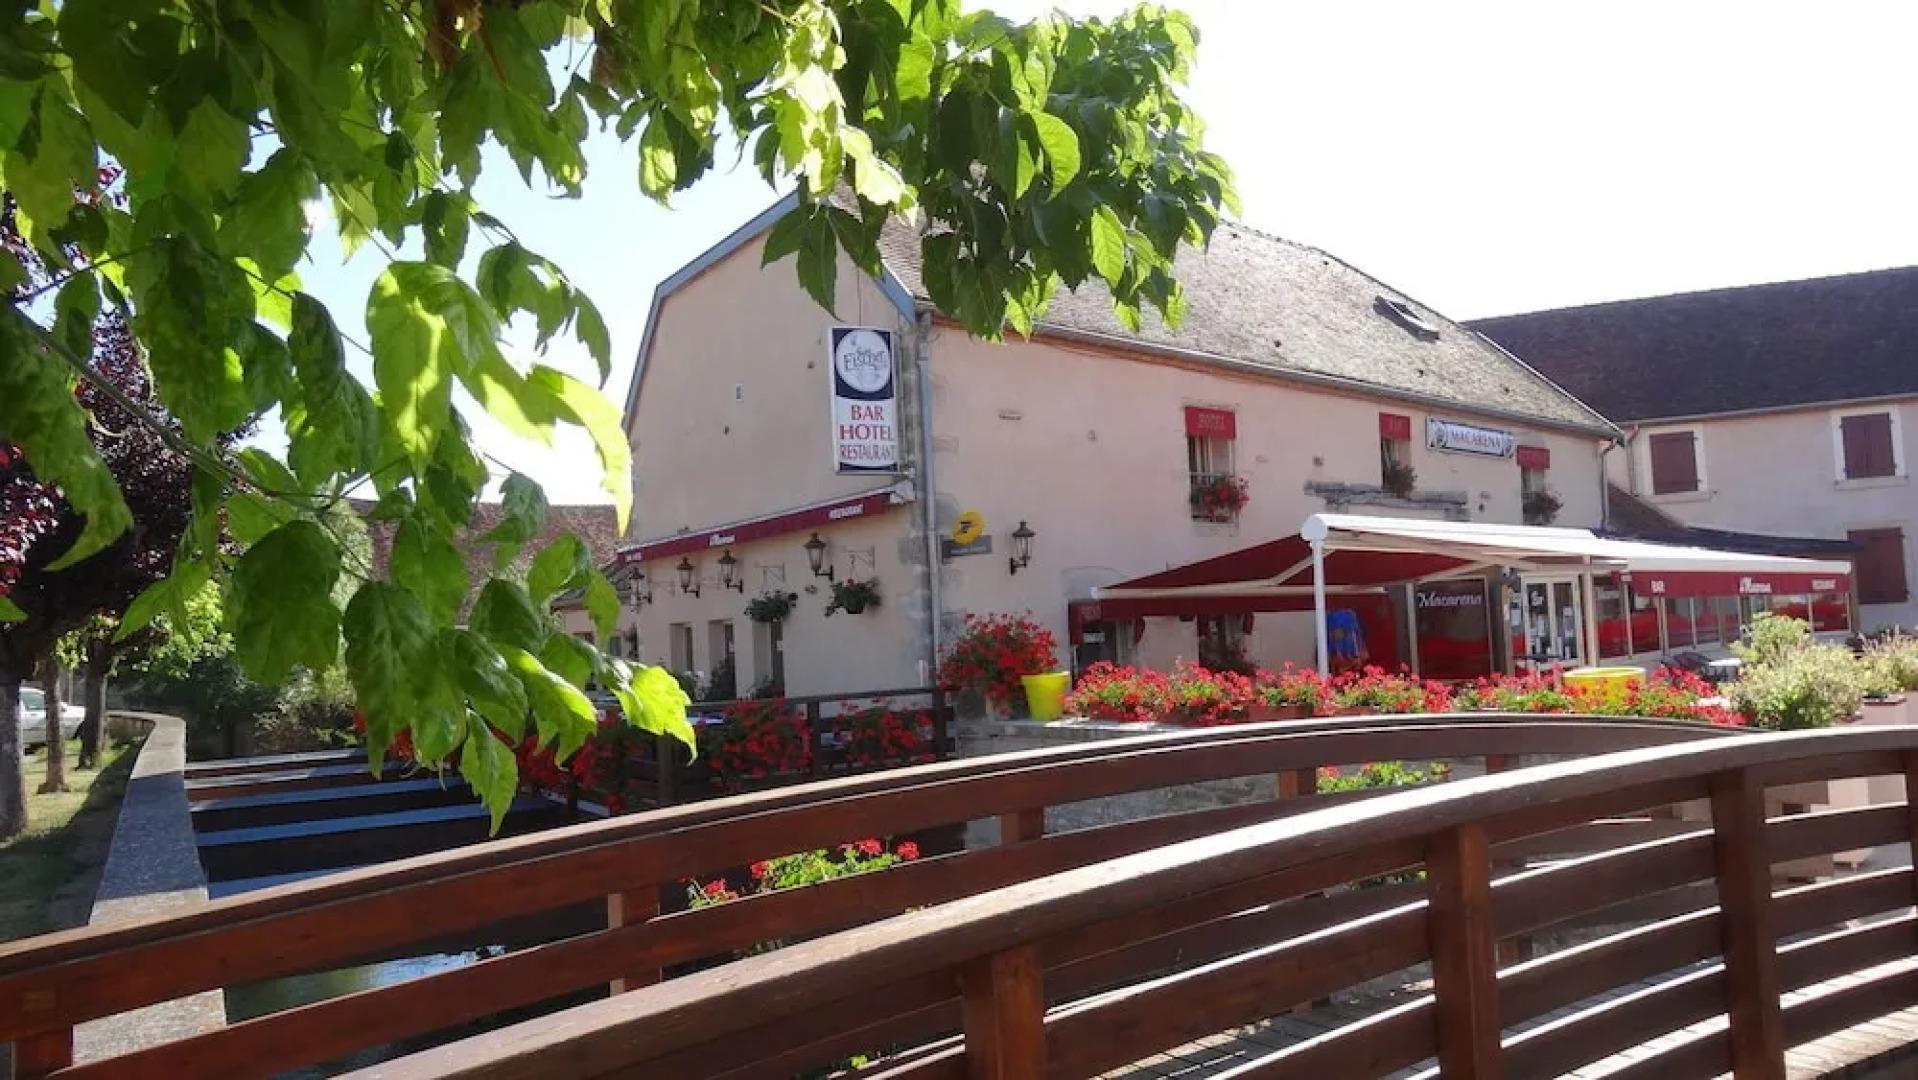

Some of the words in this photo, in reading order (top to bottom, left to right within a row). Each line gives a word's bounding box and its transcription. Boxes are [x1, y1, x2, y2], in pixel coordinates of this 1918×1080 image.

[851, 404, 885, 420] BAR
[839, 423, 894, 441] HOTEL
[1450, 430, 1502, 449] MACARENA
[840, 444, 895, 460] RESTAURANT
[1416, 591, 1482, 608] Macarena
